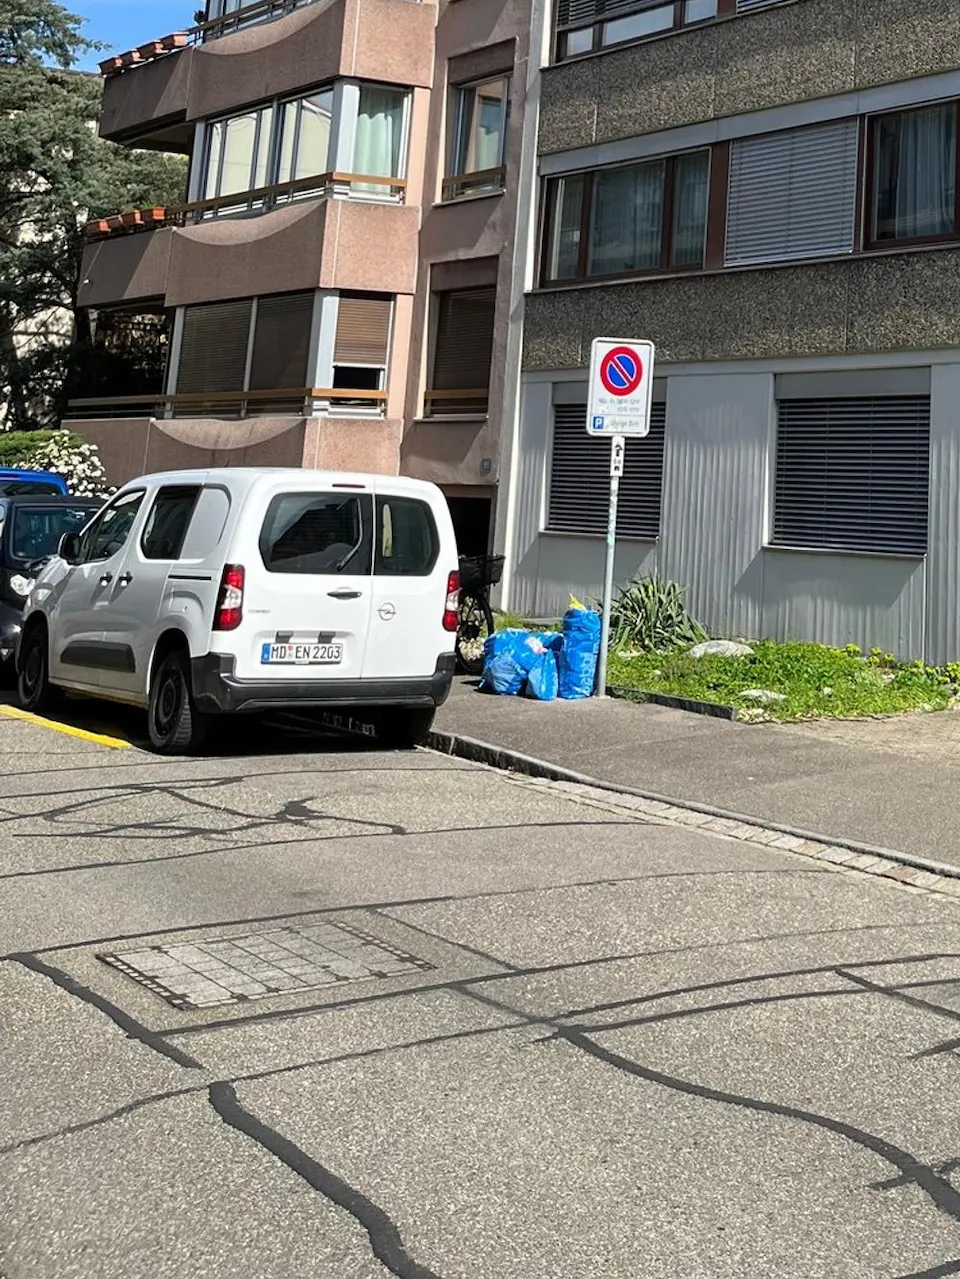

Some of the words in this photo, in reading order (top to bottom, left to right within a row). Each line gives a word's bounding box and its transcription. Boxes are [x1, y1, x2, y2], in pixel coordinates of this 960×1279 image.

[271, 646, 287, 659] MD
[295, 646, 311, 659] EN
[313, 646, 342, 659] 2203
